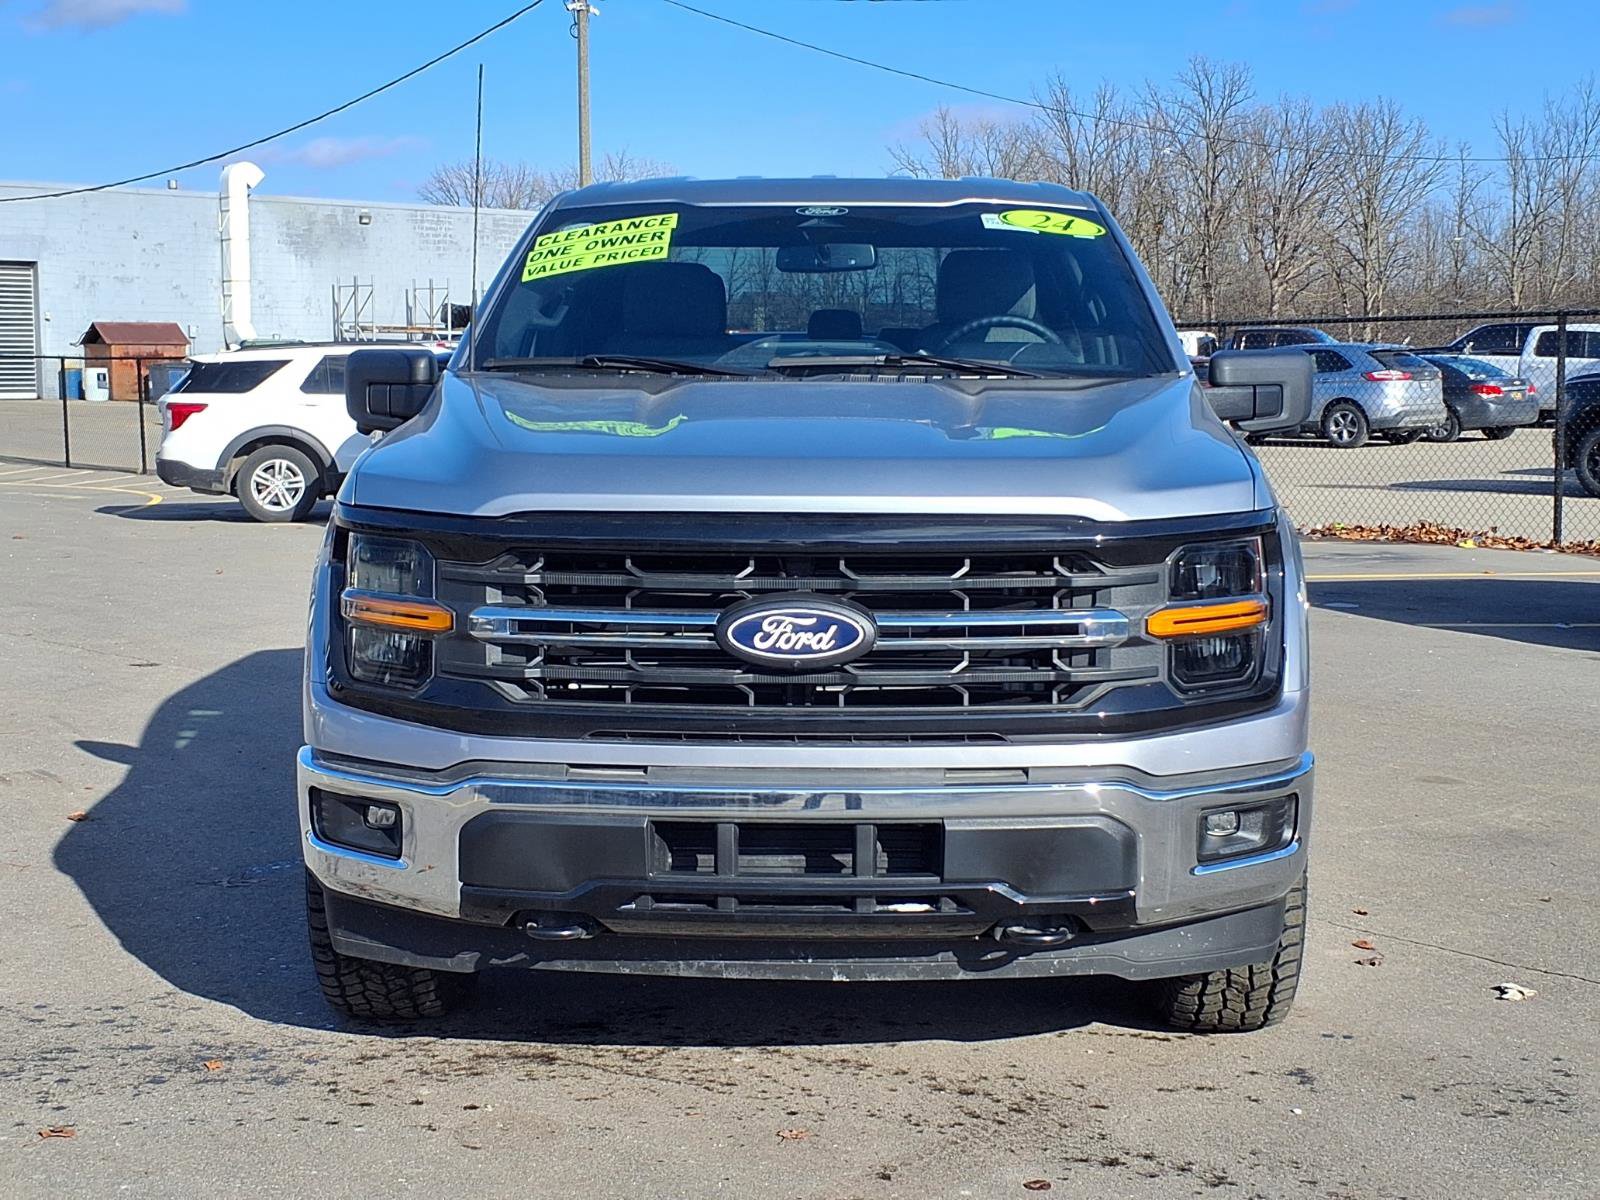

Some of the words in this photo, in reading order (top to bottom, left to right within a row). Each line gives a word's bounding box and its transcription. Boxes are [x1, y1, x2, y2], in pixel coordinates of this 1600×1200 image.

[538, 216, 673, 247] CLEARANCE
[1030, 214, 1075, 231] 24
[527, 257, 584, 277] VALUE
[593, 246, 664, 264] PRICED
[530, 244, 575, 263] ONE
[585, 230, 665, 251] OWNER
[753, 615, 838, 650] Ford
